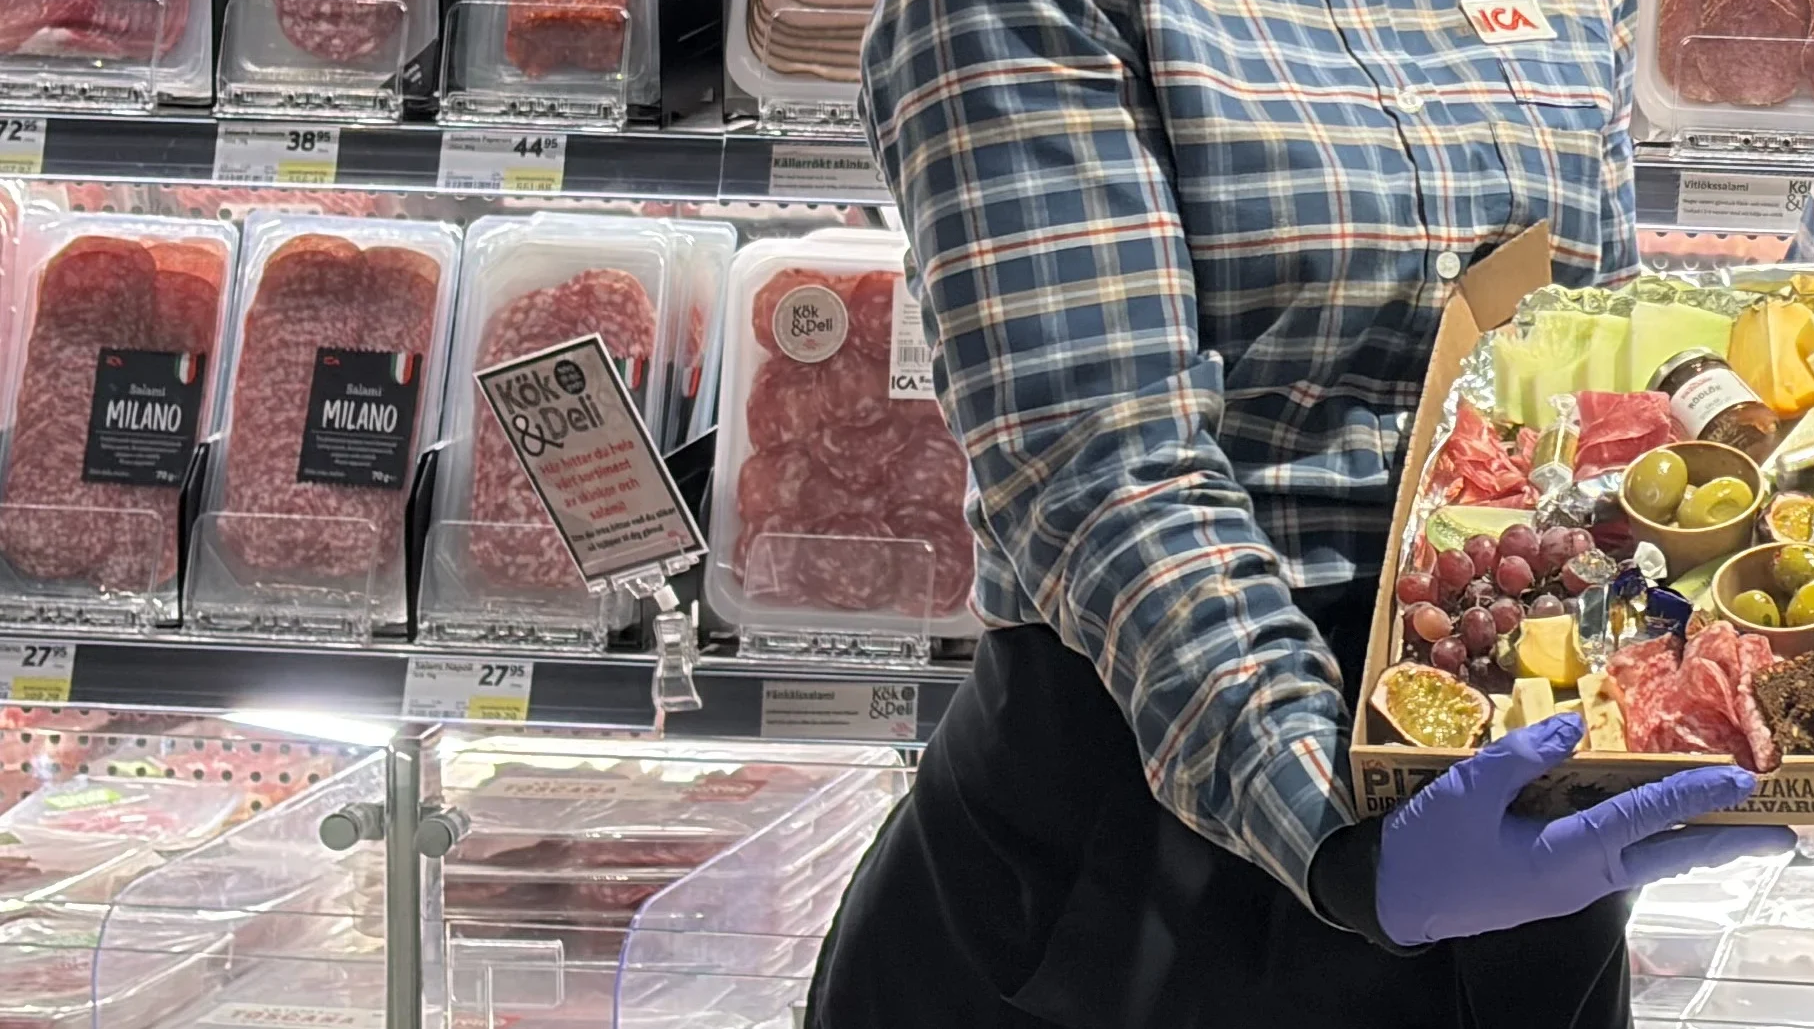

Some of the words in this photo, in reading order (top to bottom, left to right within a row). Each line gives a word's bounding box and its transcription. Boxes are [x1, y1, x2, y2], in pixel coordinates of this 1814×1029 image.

[1475, 6, 1540, 33] ICA
[286, 131, 316, 152] 38
[317, 131, 331, 143] 95
[513, 136, 543, 158] 44
[544, 138, 558, 149] 95
[834, 158, 870, 170] skinka
[1684, 179, 1750, 192] Vitlökssalami
[792, 303, 820, 319] Kök
[791, 318, 833, 337] &Deli
[129, 383, 166, 398] Salami
[346, 383, 382, 398] Salami
[495, 370, 560, 415] Kök
[891, 375, 918, 391] ICA
[106, 400, 182, 433] MILANO
[322, 400, 398, 433] MILANO
[512, 393, 605, 457] &Deli
[21, 645, 52, 667] 27
[52, 646, 67, 659] 95
[478, 664, 509, 687] 27
[509, 665, 525, 678] 95
[872, 685, 899, 701] Kök
[869, 701, 914, 720] &Deli
